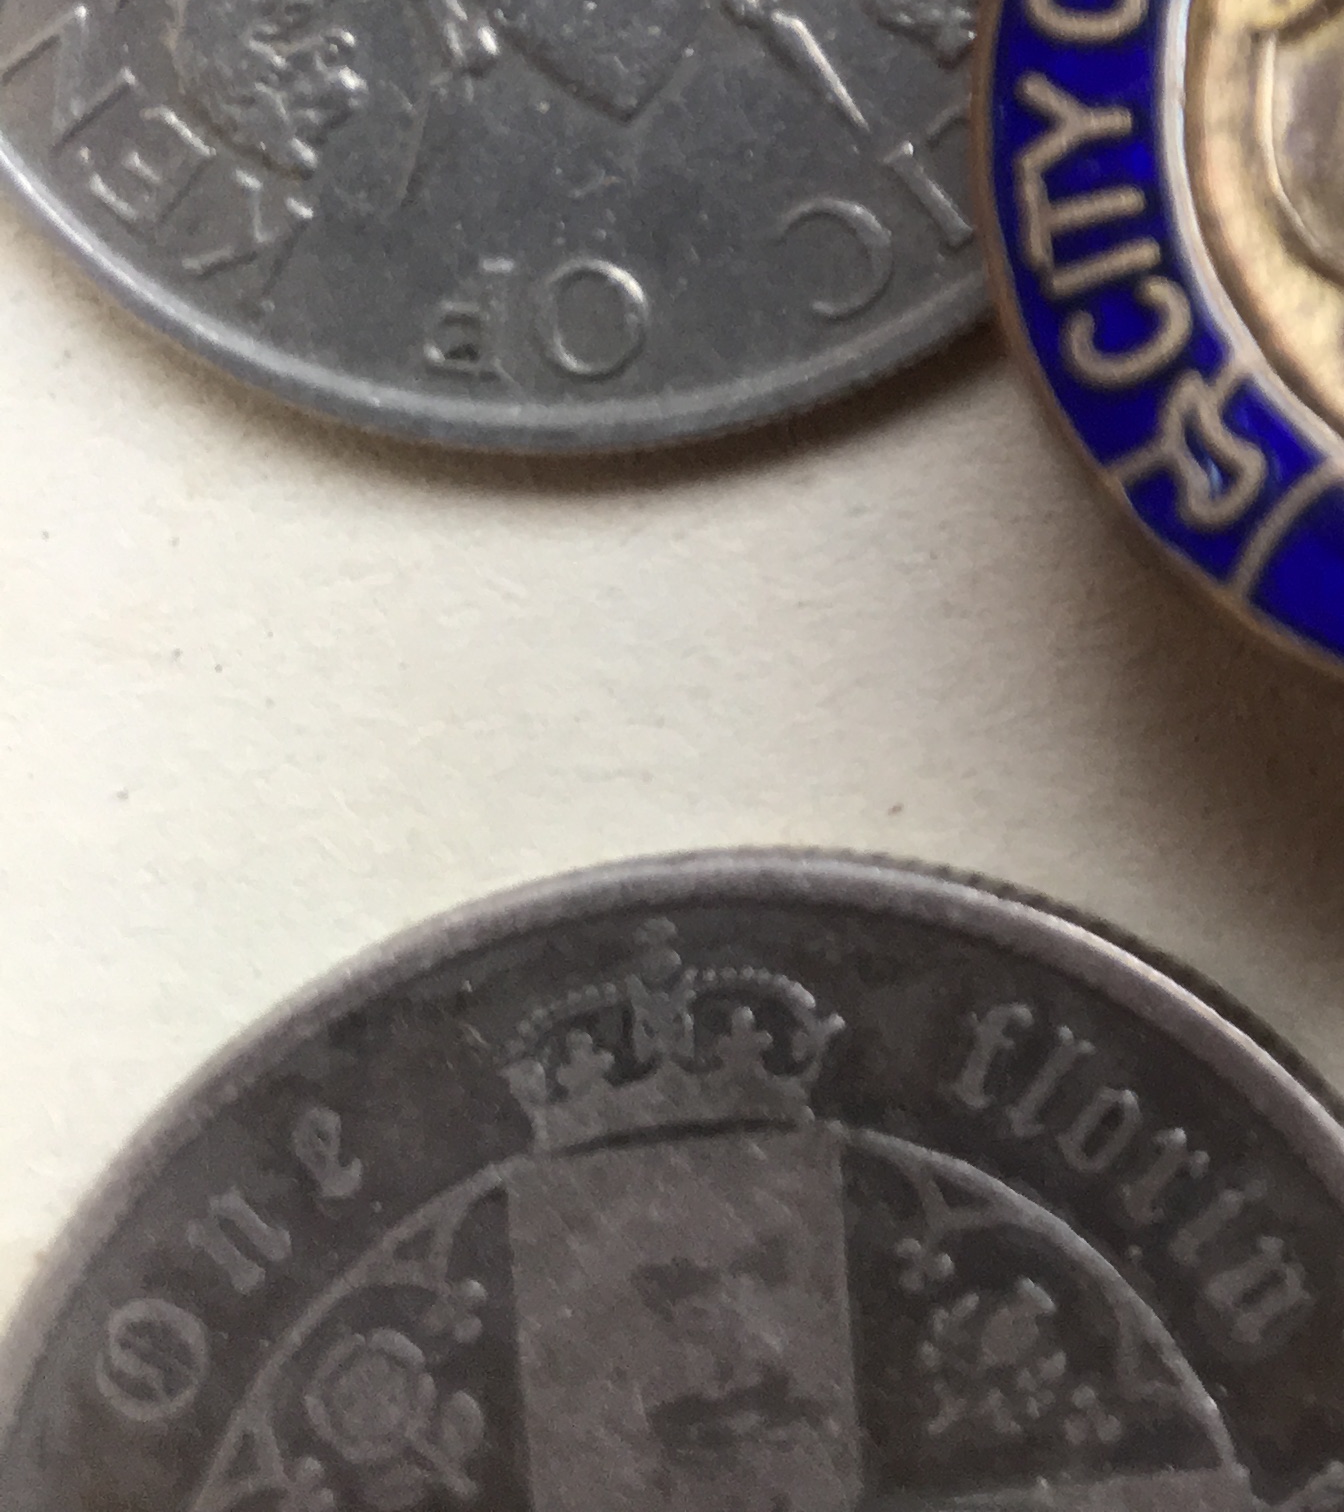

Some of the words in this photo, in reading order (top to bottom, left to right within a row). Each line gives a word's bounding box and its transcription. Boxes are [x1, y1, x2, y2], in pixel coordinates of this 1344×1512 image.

[1016, 71, 1192, 388] CITY
[92, 1105, 365, 1423] One
[950, 1003, 1315, 1350] florin
